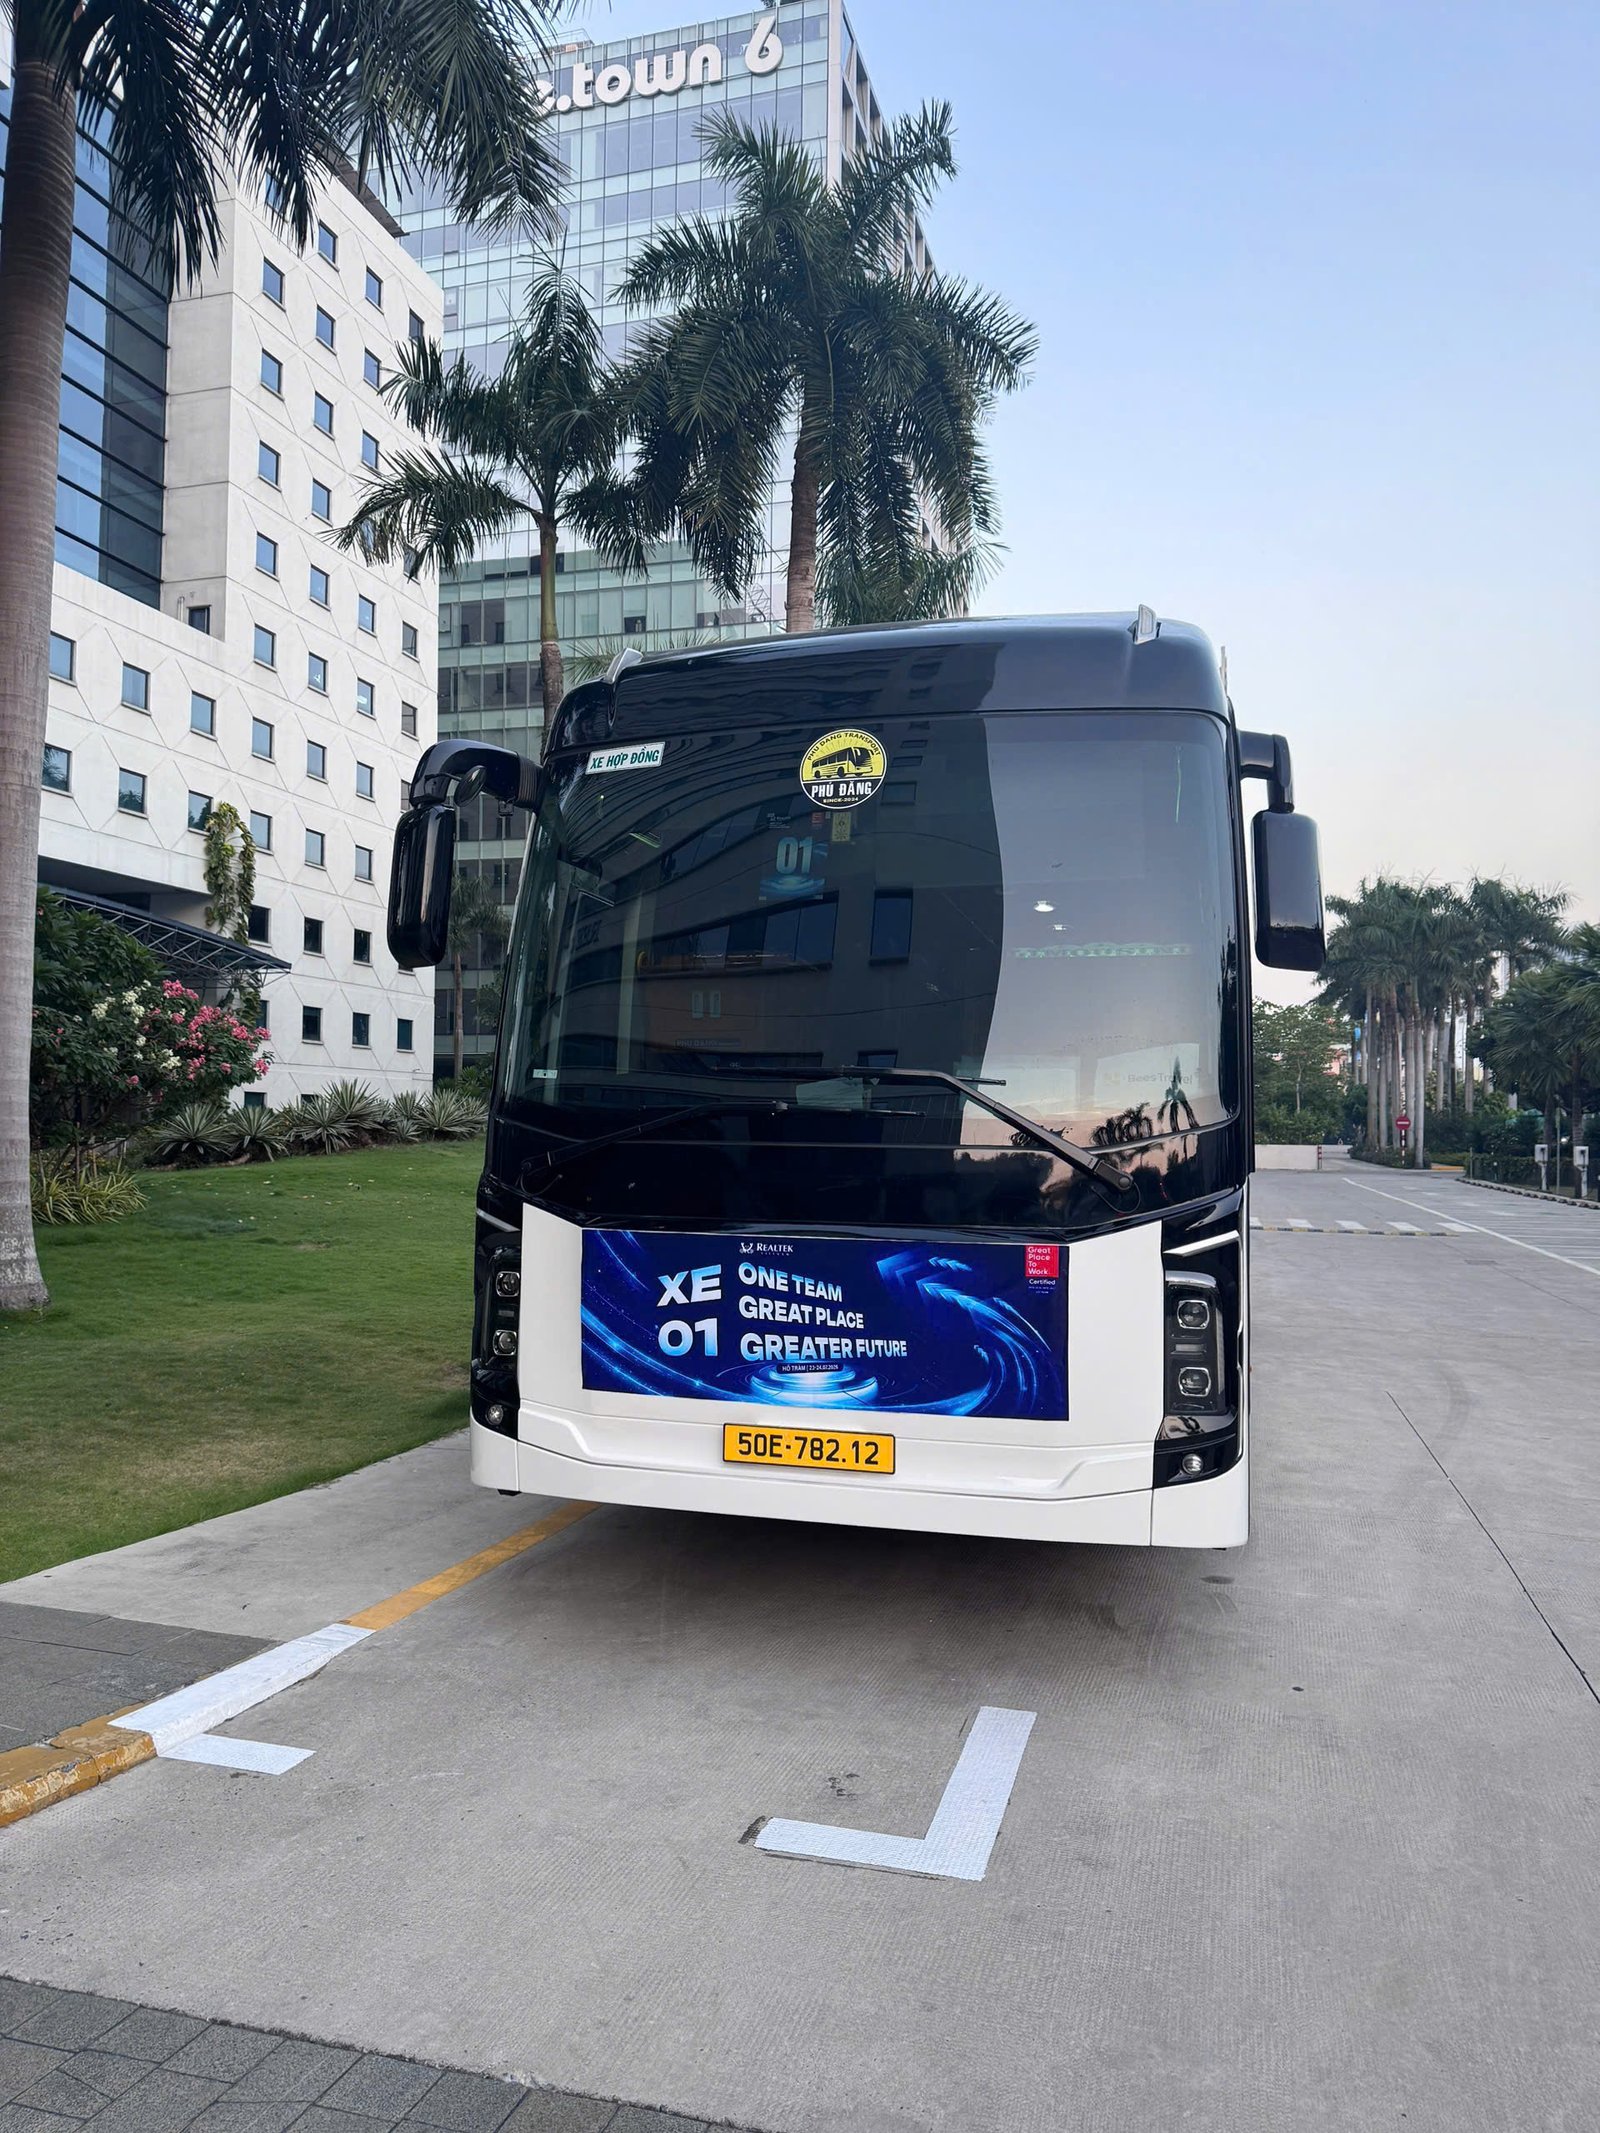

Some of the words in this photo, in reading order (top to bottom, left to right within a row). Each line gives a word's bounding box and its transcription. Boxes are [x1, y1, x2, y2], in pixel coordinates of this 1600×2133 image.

[745, 17, 784, 76] 6
[590, 756, 604, 769] XE
[606, 752, 628, 768] HỢP
[630, 746, 660, 764] ĐỒNG
[807, 746, 819, 761] PHU
[844, 732, 881, 756] TRANSPORT
[811, 781, 834, 798] PHÚ
[838, 780, 872, 796] ĐĂNG
[776, 836, 813, 875] 01
[756, 1242, 793, 1253] REALTEK
[1028, 1246, 1051, 1254] Great
[656, 1264, 722, 1307] XE
[738, 1262, 789, 1292] ONE
[791, 1275, 843, 1302] TEAM
[738, 1295, 813, 1324] GREAT
[815, 1308, 864, 1329] PLACE
[658, 1317, 719, 1357] 01
[740, 1332, 854, 1361] GREATER
[856, 1338, 908, 1358] FUTURE
[738, 1432, 879, 1465] 50E-782.12
